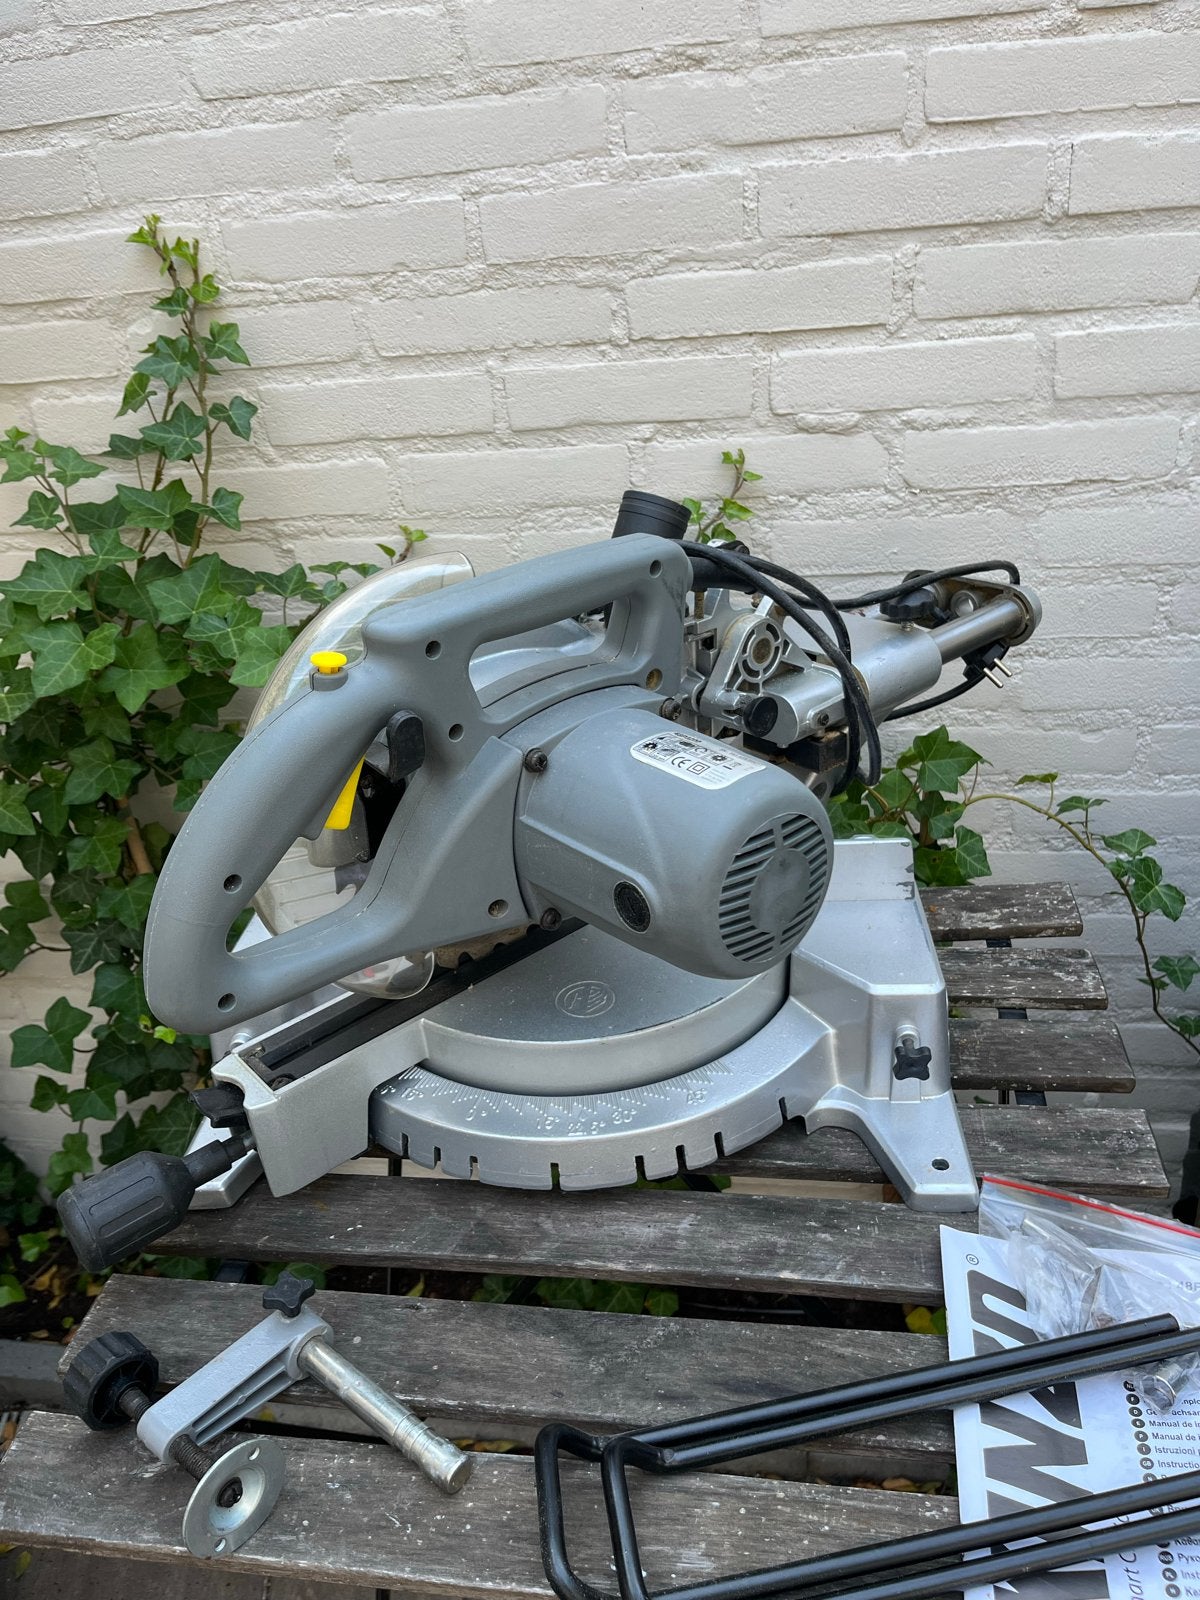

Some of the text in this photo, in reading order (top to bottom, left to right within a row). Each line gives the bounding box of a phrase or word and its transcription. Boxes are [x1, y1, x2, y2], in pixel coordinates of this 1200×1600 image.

[671, 756, 691, 769] CE
[612, 1107, 638, 1125] 30°
[1149, 1420, 1180, 1428] Manual
[1182, 1420, 1192, 1428] de
[1152, 1433, 1183, 1441] Manual
[1185, 1433, 1196, 1441] de
[1155, 1446, 1195, 1456] Istruzioni
